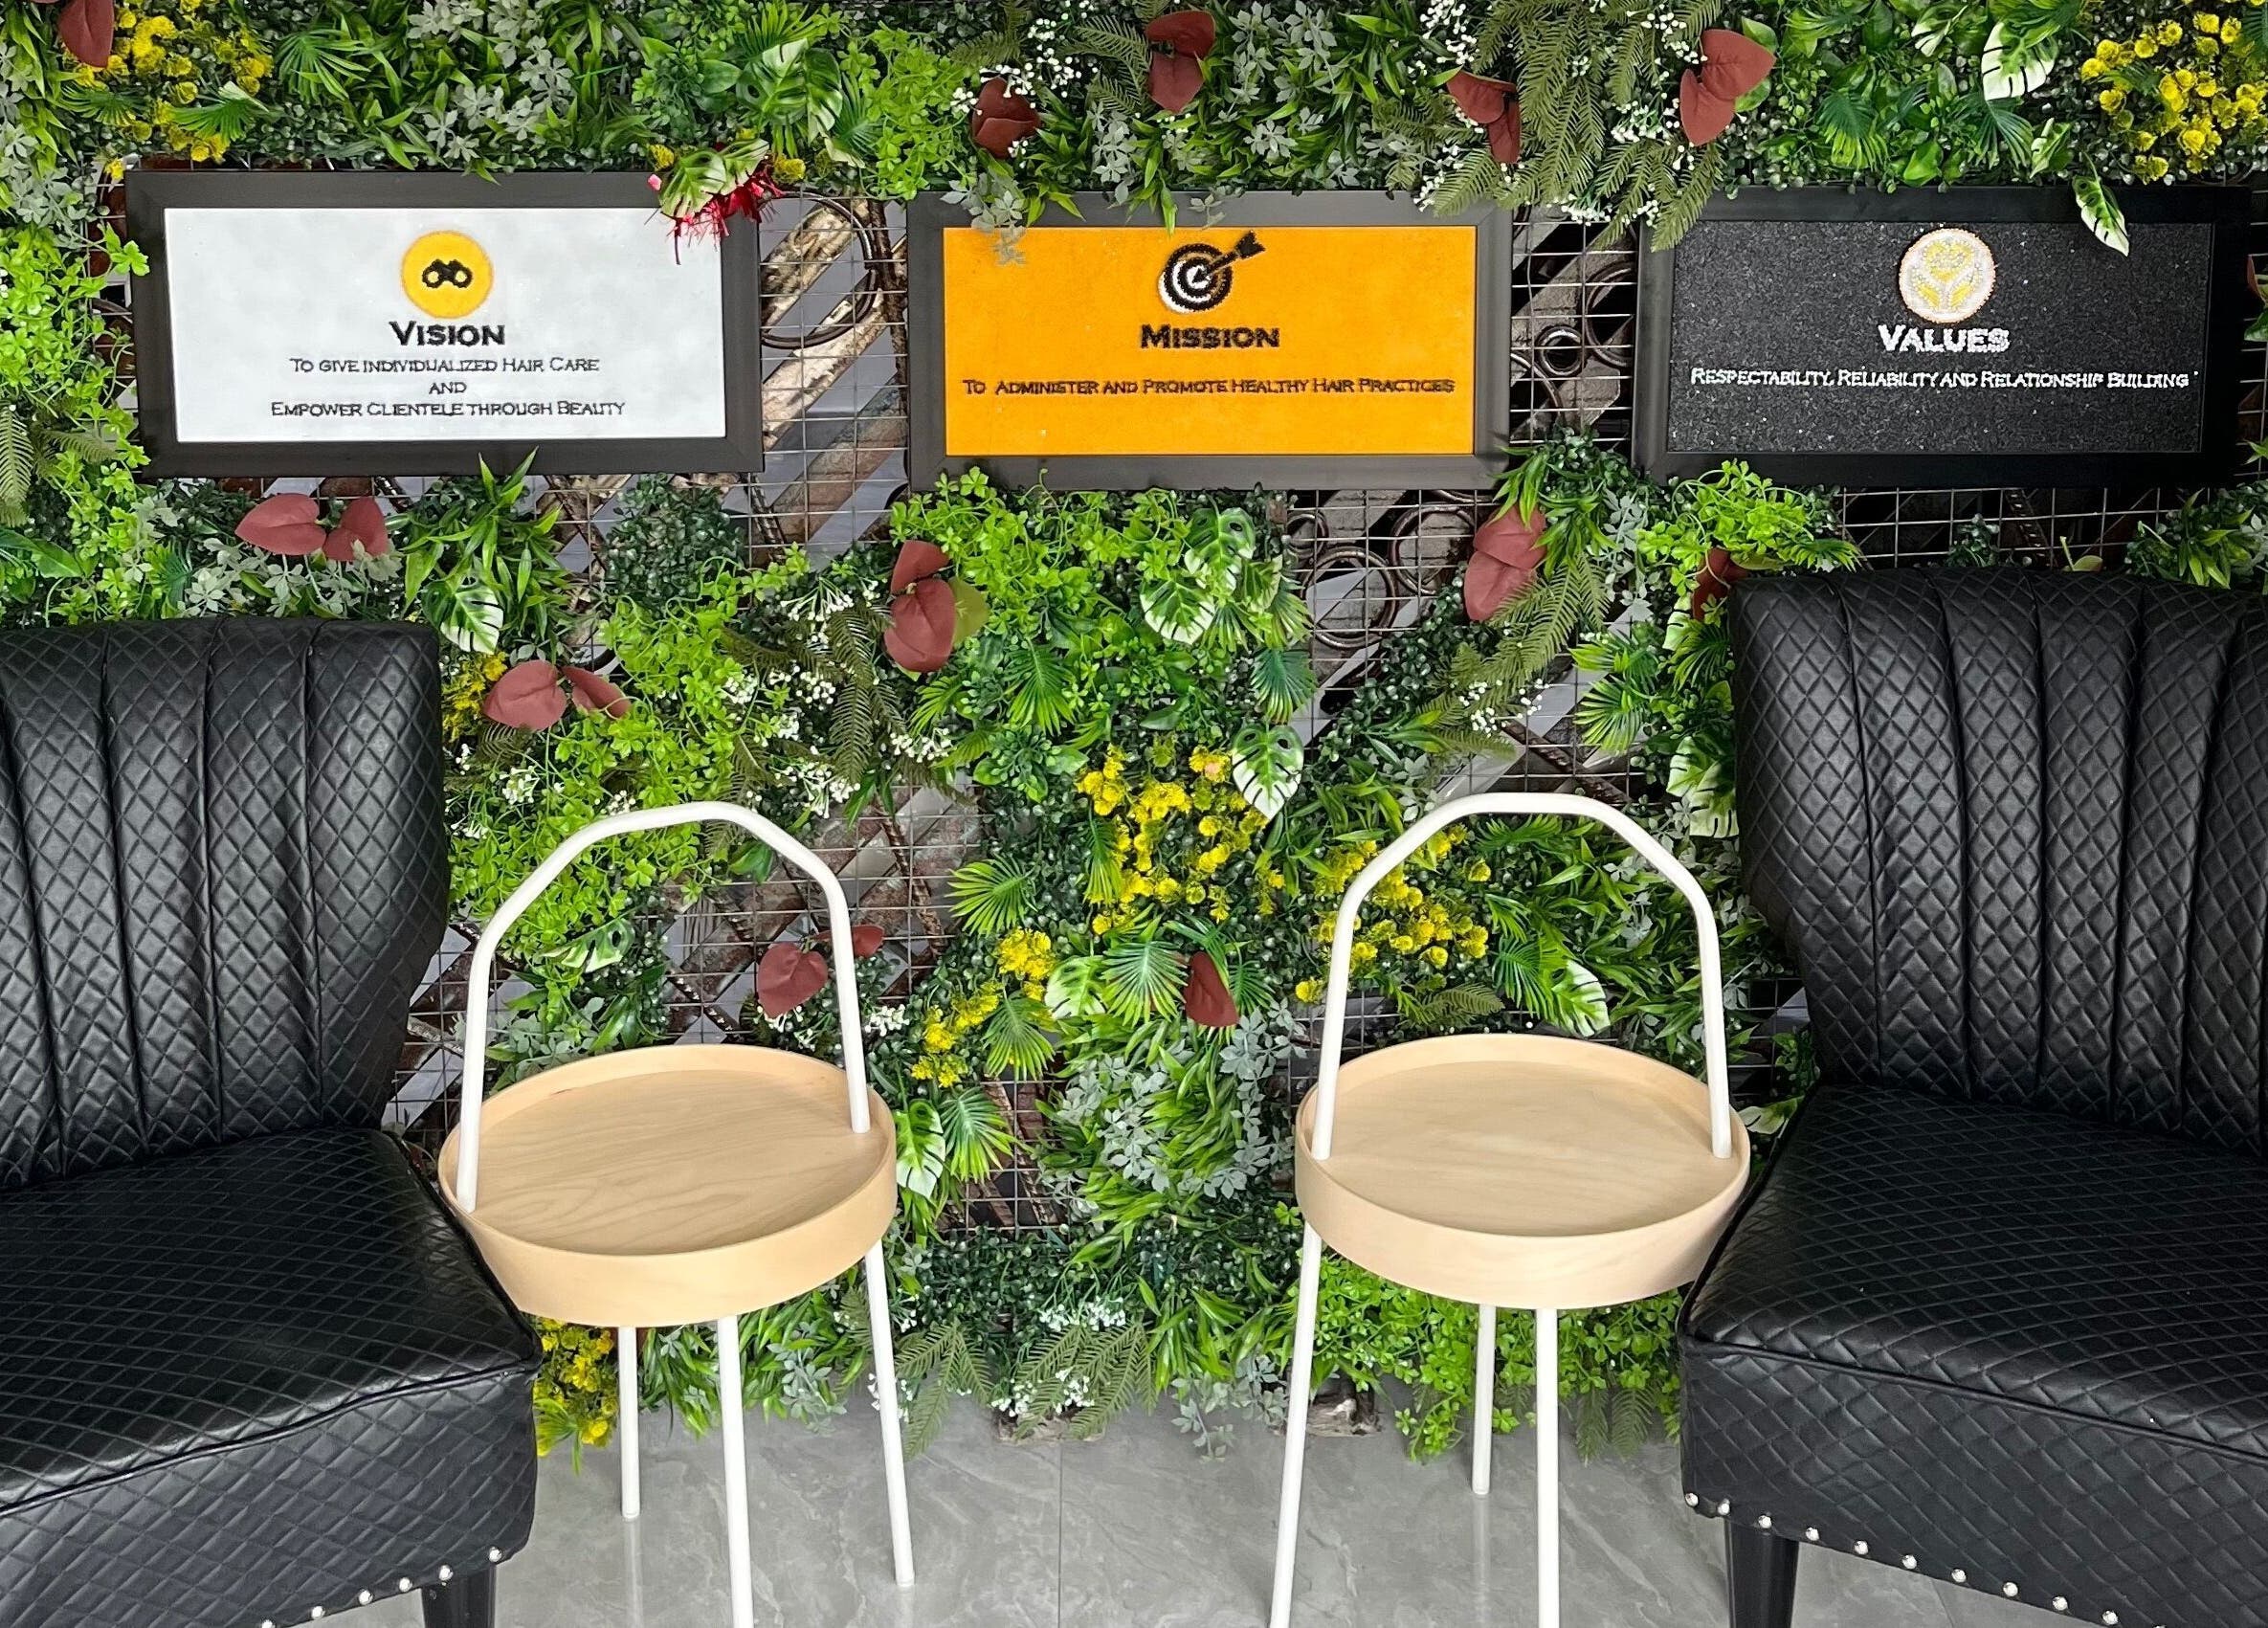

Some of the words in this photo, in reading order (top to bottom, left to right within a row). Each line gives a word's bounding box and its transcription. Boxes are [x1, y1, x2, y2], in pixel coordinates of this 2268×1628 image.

[389, 321, 506, 346] VISION
[1140, 323, 1280, 348] MISSION
[1878, 324, 2011, 353] VALUES
[289, 358, 314, 372] TO
[318, 359, 360, 372] GIVE
[502, 358, 545, 371] HAIR
[549, 357, 600, 371] CARE
[428, 382, 468, 394] AND
[963, 379, 986, 394] TO
[995, 380, 1100, 394] ADMINISTER
[1102, 381, 1138, 393] AND
[1143, 379, 1228, 393] PROMOTE
[1231, 379, 1310, 393] HEALTHY
[1313, 379, 1354, 393] HAIR
[1837, 368, 1940, 387] RELIABILITY
[1941, 371, 1978, 387] AND
[1980, 370, 2104, 389] RELATIONSHIP
[271, 402, 363, 417] EMPOWER
[367, 402, 464, 416] CLIENTELE
[467, 402, 553, 416] THROUGH
[557, 400, 626, 416] BEAUTY
